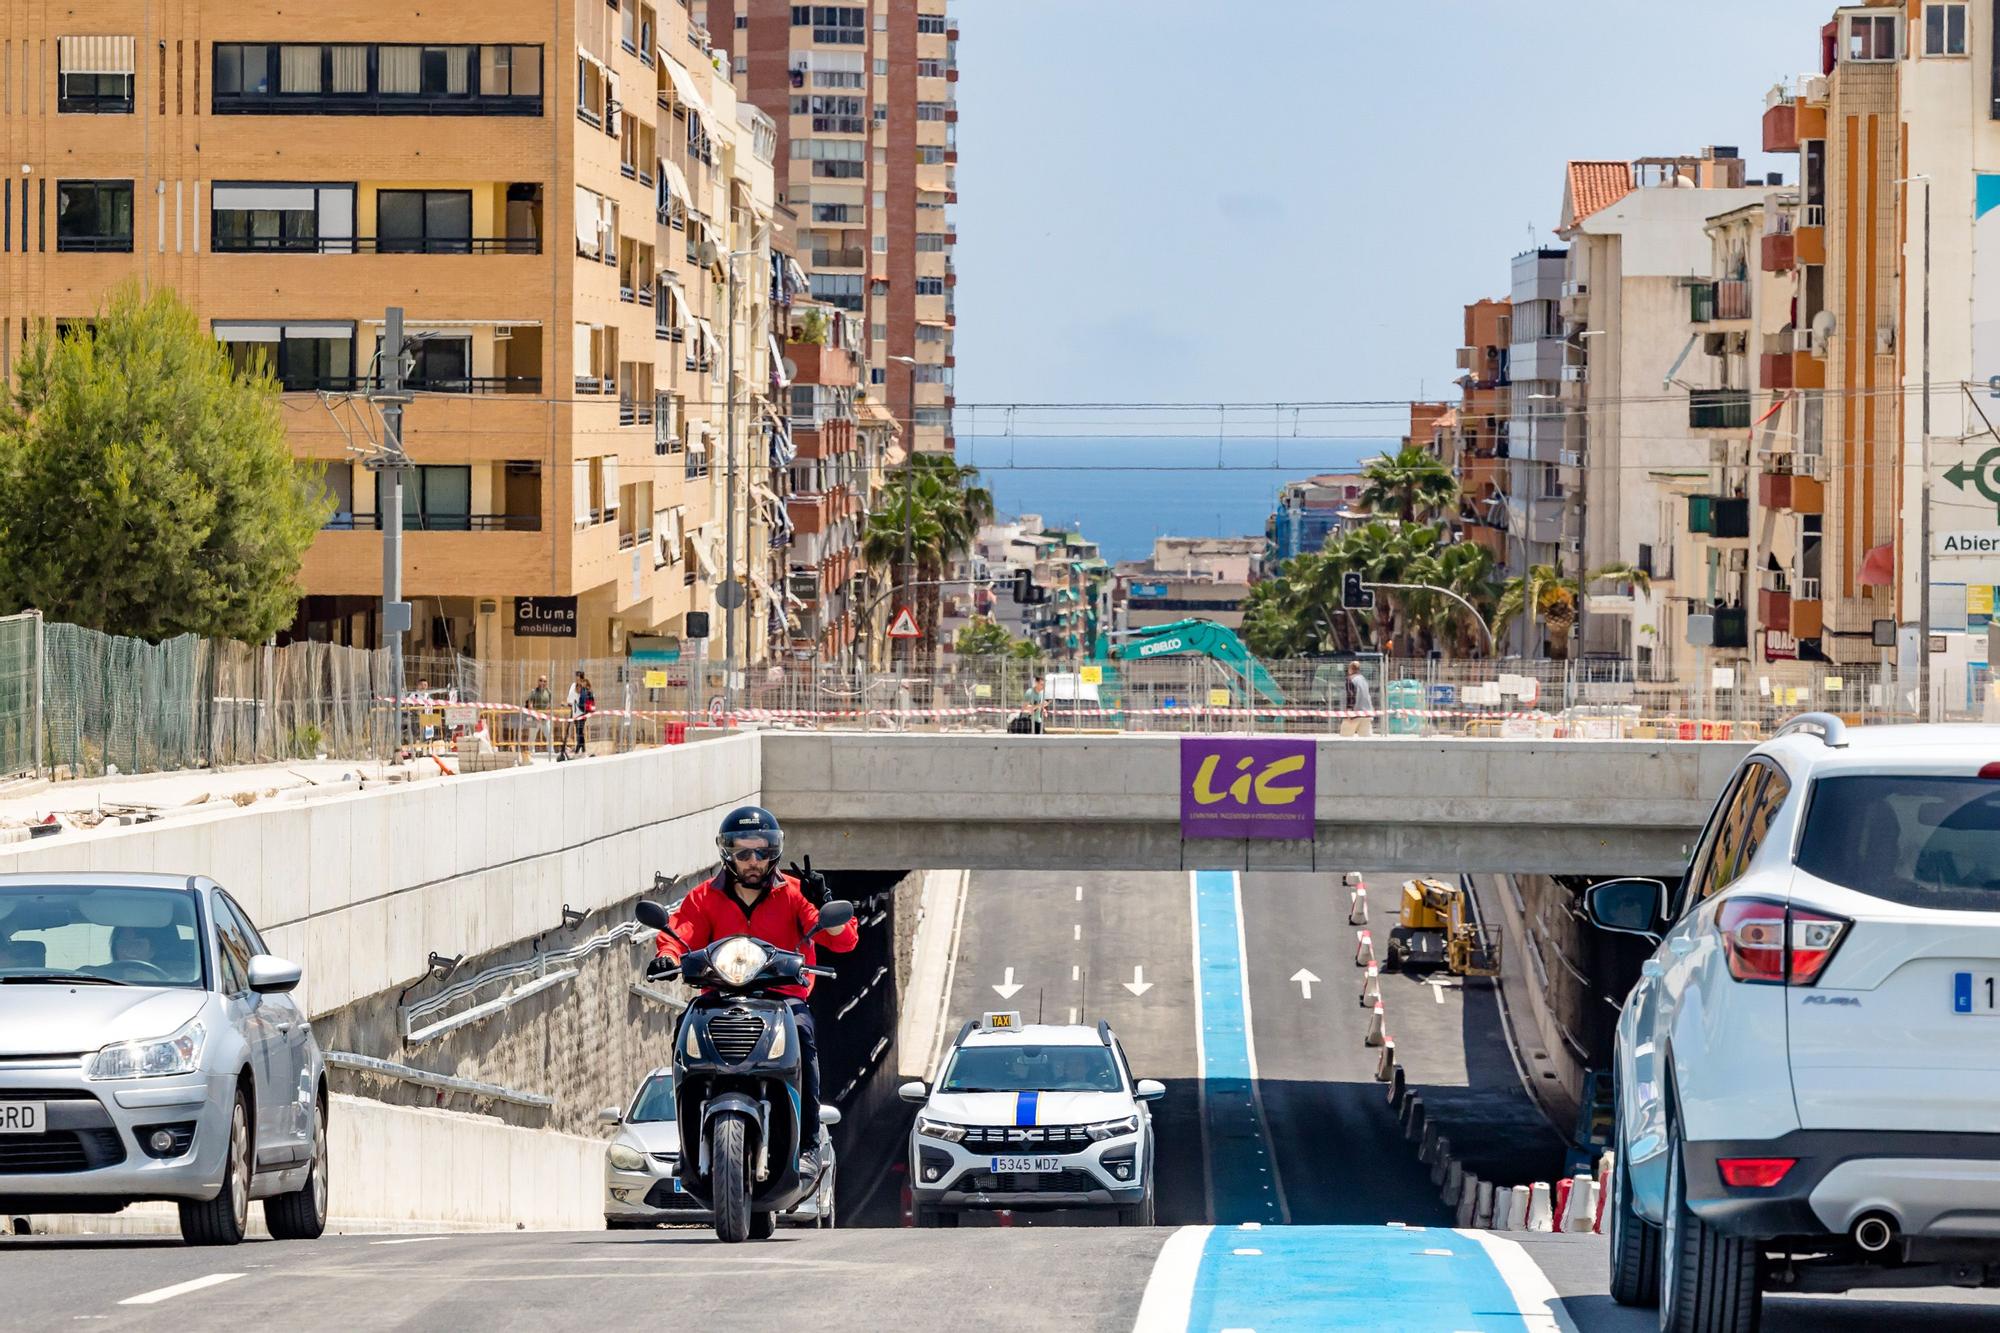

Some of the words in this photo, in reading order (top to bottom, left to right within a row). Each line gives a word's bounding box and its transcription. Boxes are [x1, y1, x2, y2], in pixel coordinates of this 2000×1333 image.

[1944, 535, 2000, 551] Abier
[1140, 638, 1182, 656] KOBELCO
[992, 1015, 1012, 1027] TAXI
[0, 1106, 34, 1129] RD
[999, 1158, 1031, 1171] 5345
[1034, 1158, 1060, 1171] MDZ
